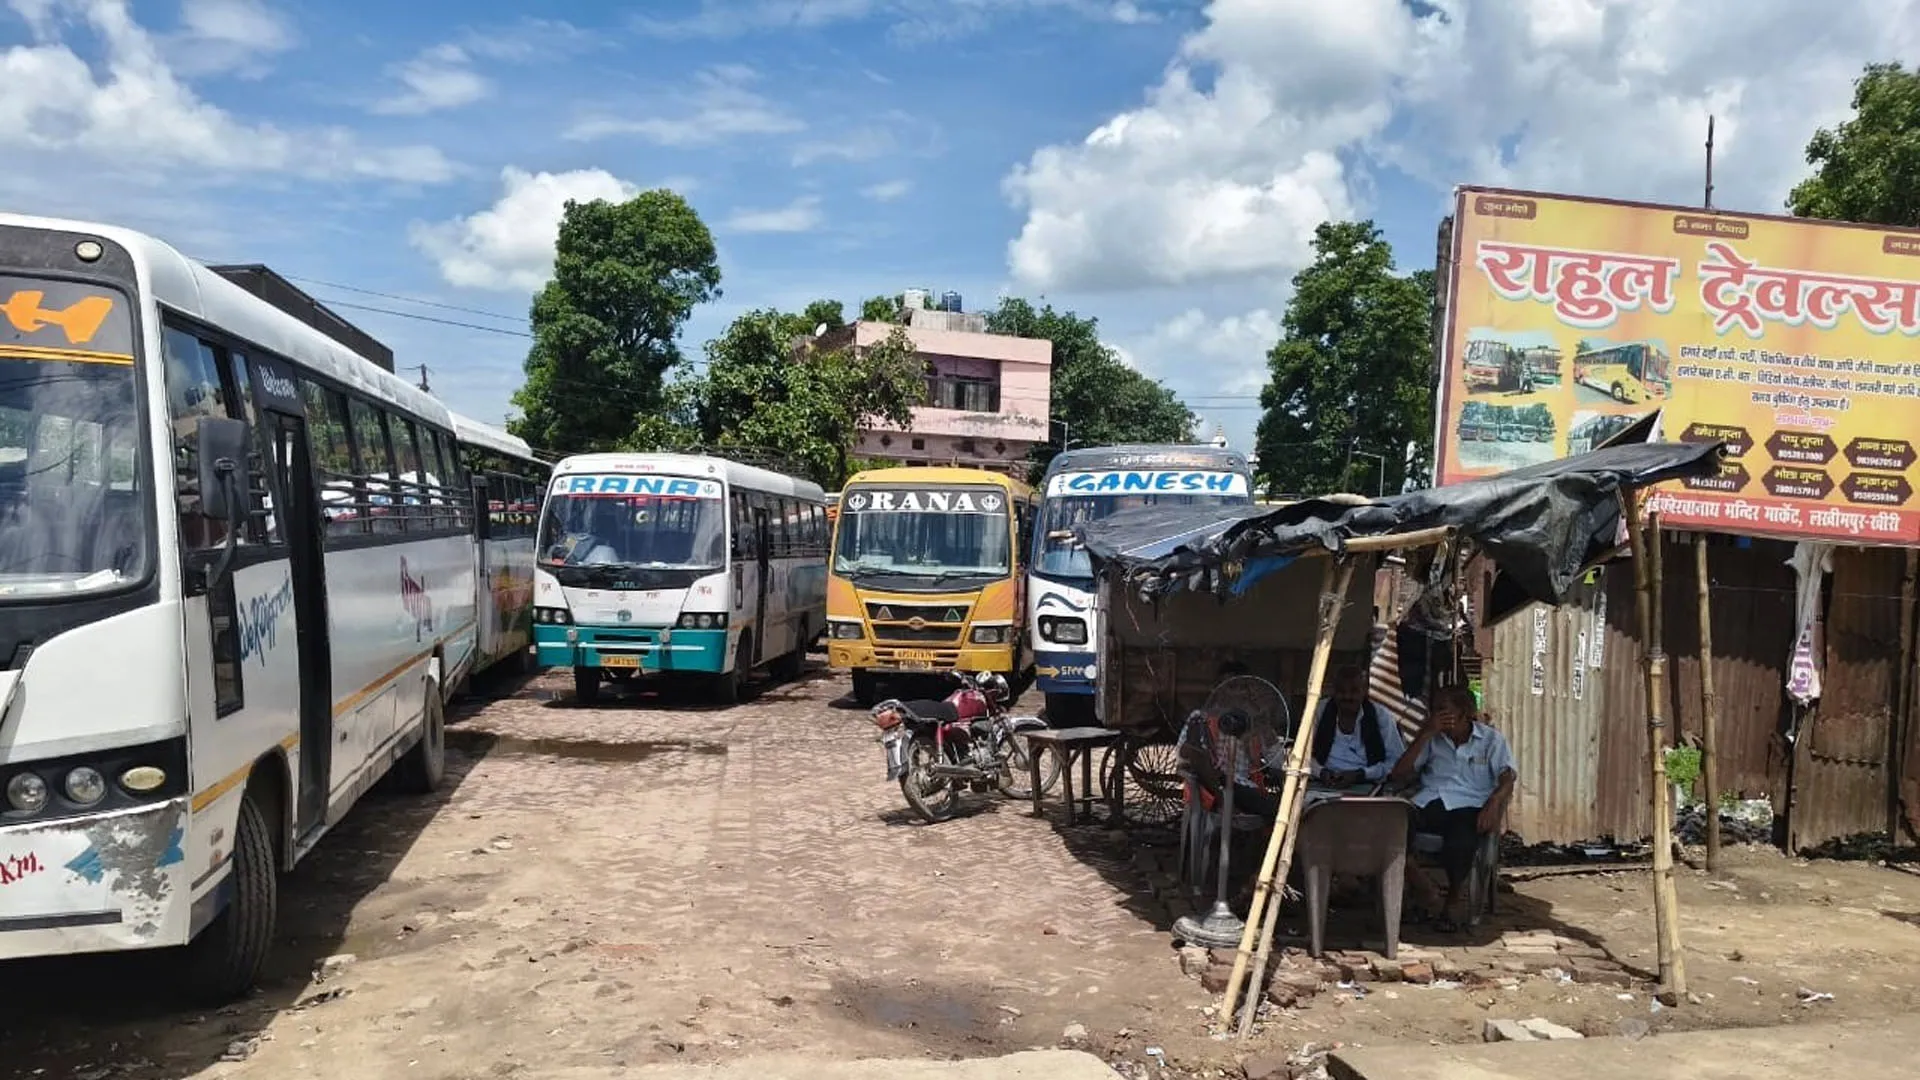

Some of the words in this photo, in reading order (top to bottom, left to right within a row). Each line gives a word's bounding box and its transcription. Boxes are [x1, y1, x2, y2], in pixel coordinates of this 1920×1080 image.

[1478, 242, 1678, 322] राहुल
[1699, 242, 1920, 334] ट्रेवल्स
[1718, 429, 1742, 442] गुप्ता
[1800, 436, 1824, 449] गुप्ता
[569, 477, 699, 495] RANA
[1068, 472, 1235, 491] GANESH
[1799, 471, 1824, 484] गुप्ता
[869, 491, 976, 512] RANA
[1724, 499, 1760, 521] मन्दिर
[1808, 507, 1901, 534] लखीमपुर-खीरी
